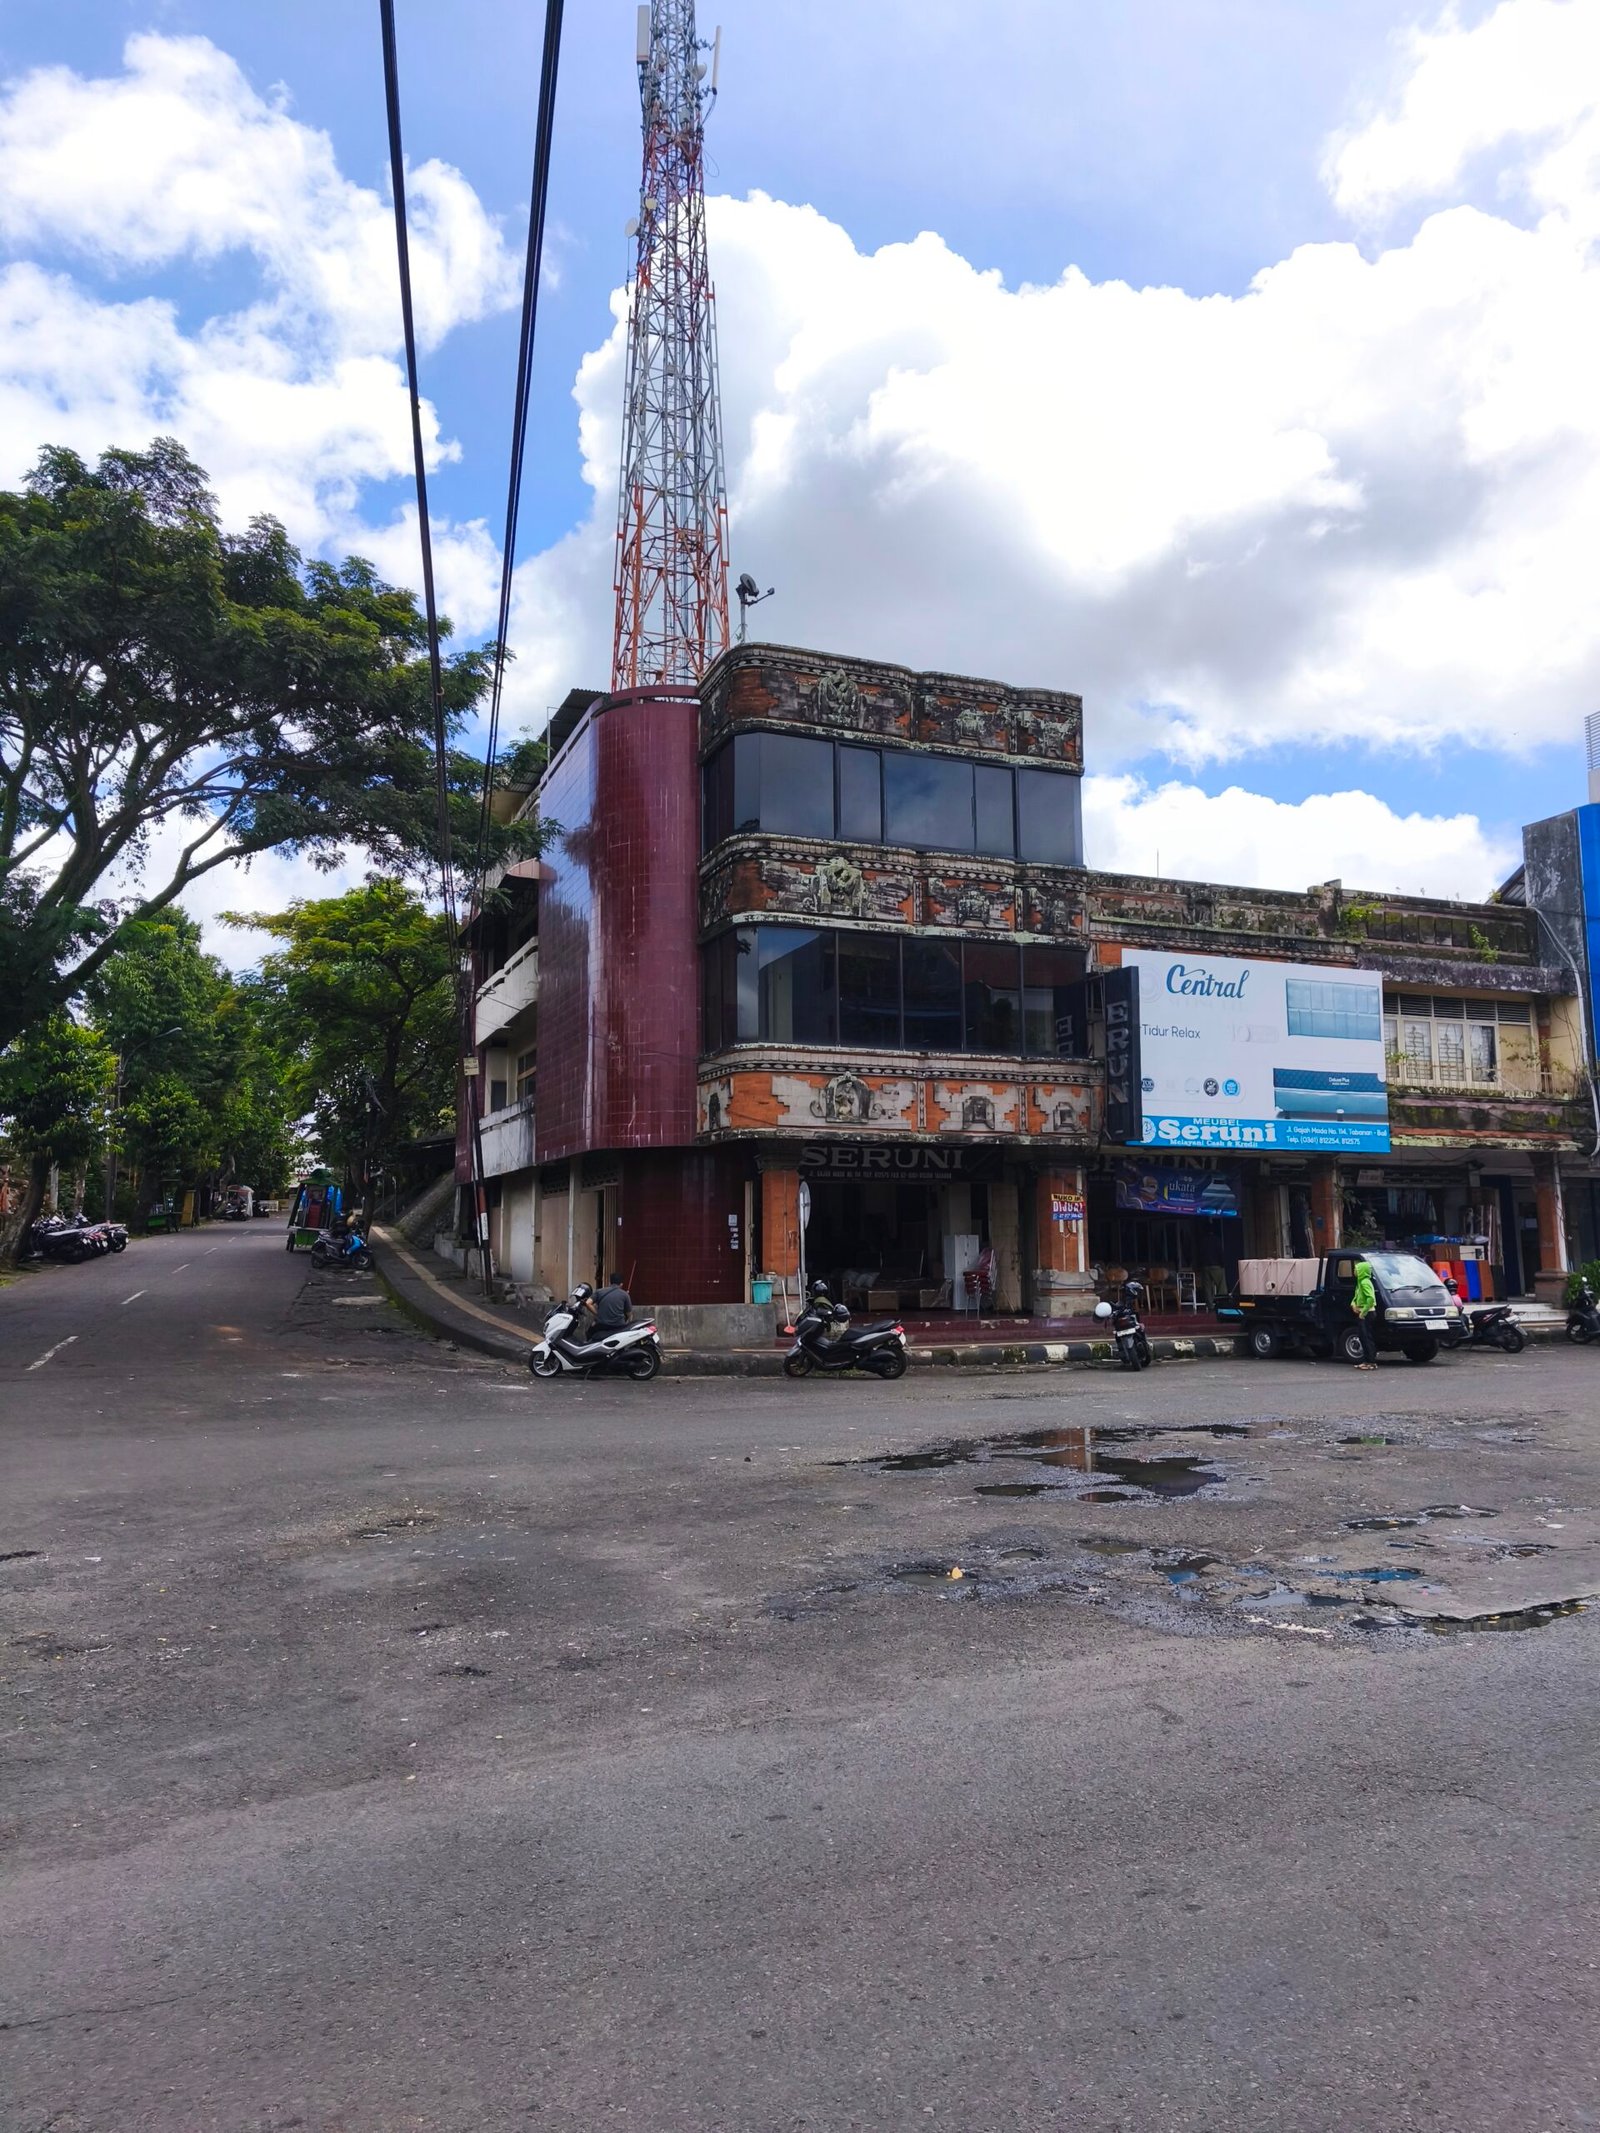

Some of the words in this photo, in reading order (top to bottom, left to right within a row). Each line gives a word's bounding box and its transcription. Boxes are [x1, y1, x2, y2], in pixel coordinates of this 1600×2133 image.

[1166, 964, 1250, 998] Central
[1142, 1024, 1168, 1037] Tidur
[1171, 1026, 1200, 1039] Relax
[1193, 1117, 1243, 1126] MEUBEL
[1157, 1118, 1277, 1142] Seruni
[1349, 1128, 1373, 1136] Tabanan
[1377, 1129, 1388, 1137] Bali
[1169, 1138, 1204, 1147] Melayani
[1206, 1139, 1225, 1147] Cash
[1235, 1140, 1259, 1148] Kredit
[800, 1146, 963, 1169] SERUNI
